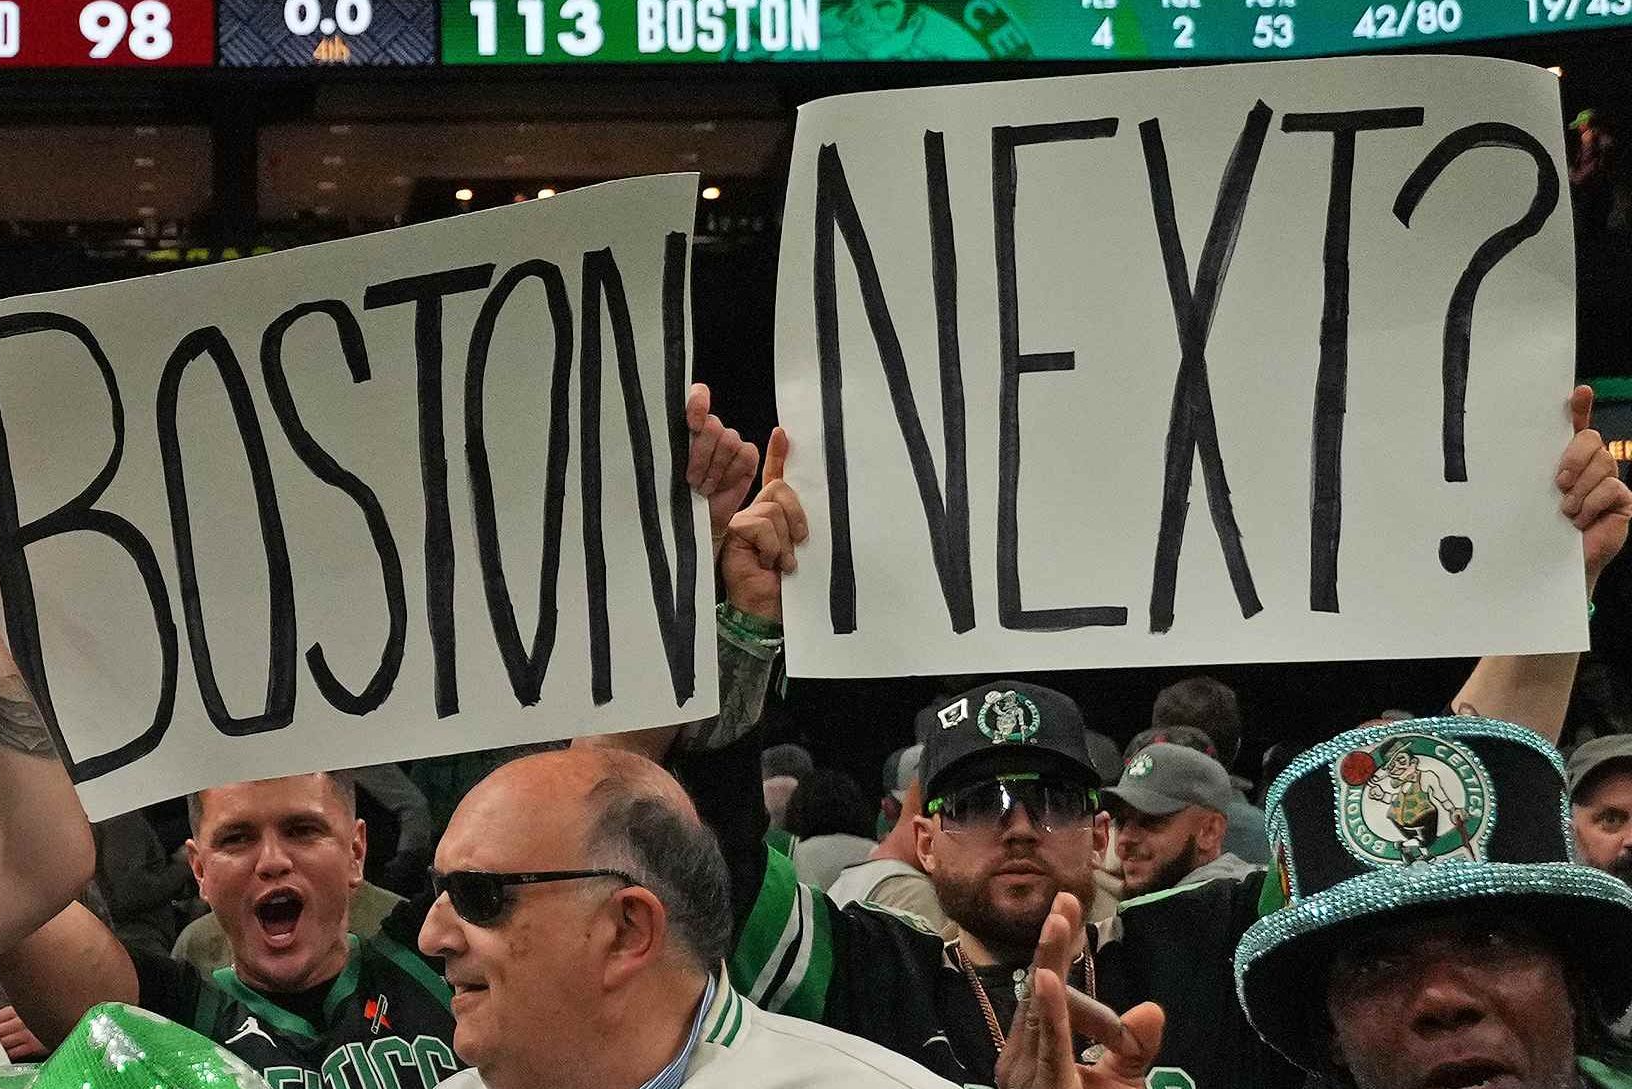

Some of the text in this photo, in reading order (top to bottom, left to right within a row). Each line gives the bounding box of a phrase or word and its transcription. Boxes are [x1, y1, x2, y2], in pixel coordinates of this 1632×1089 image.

[78, 0, 174, 61] 98
[283, 0, 373, 36] 0.0
[469, 0, 820, 57] 113 BOSTON
[1091, 16, 1114, 49] 4
[1172, 14, 1196, 49] 2
[1252, 14, 1296, 49] 53
[1352, 0, 1463, 39] 42/80
[813, 98, 1560, 635] NEXT?
[1434, 745, 1483, 818] CELTICS
[1346, 788, 1386, 853] BOSTON
